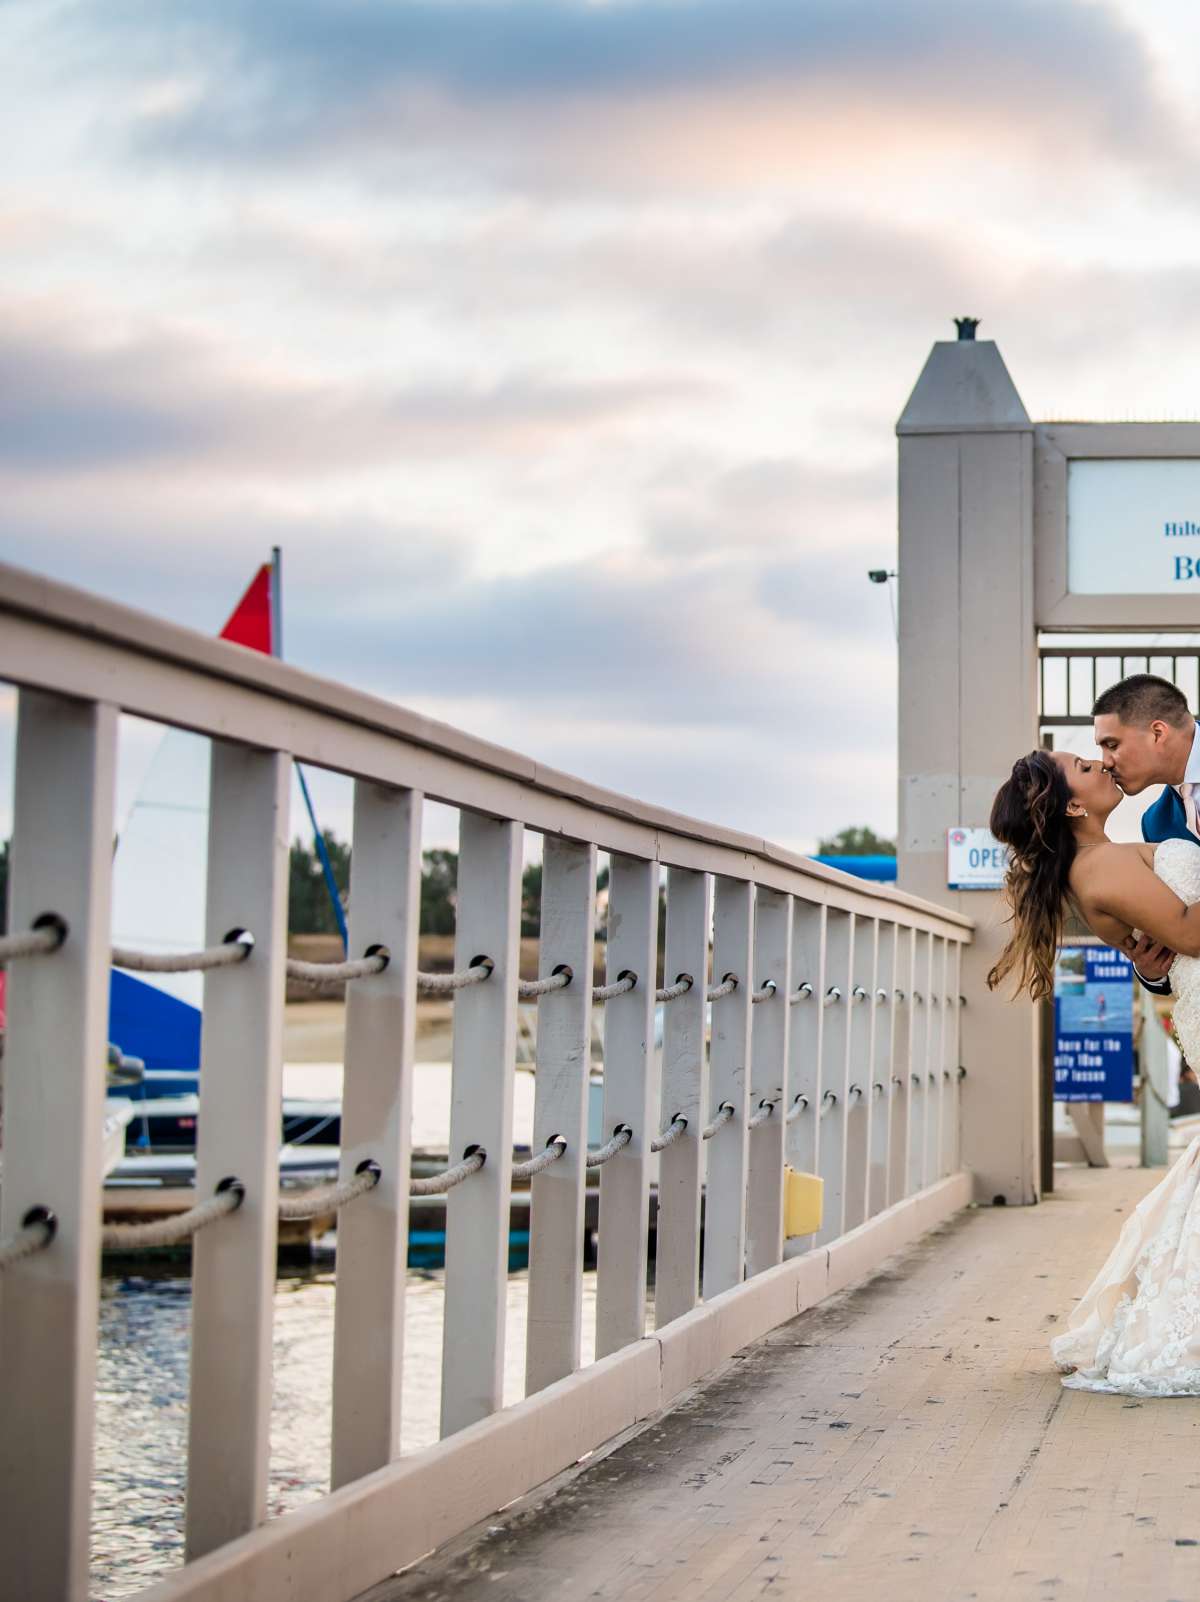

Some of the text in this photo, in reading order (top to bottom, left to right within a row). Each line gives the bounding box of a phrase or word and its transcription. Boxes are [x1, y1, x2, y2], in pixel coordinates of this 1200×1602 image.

[1086, 949, 1116, 962] Stand
[1058, 1038, 1121, 1052] here for the
[1054, 1053, 1074, 1069] aily
[1071, 1070, 1106, 1082] lesson
